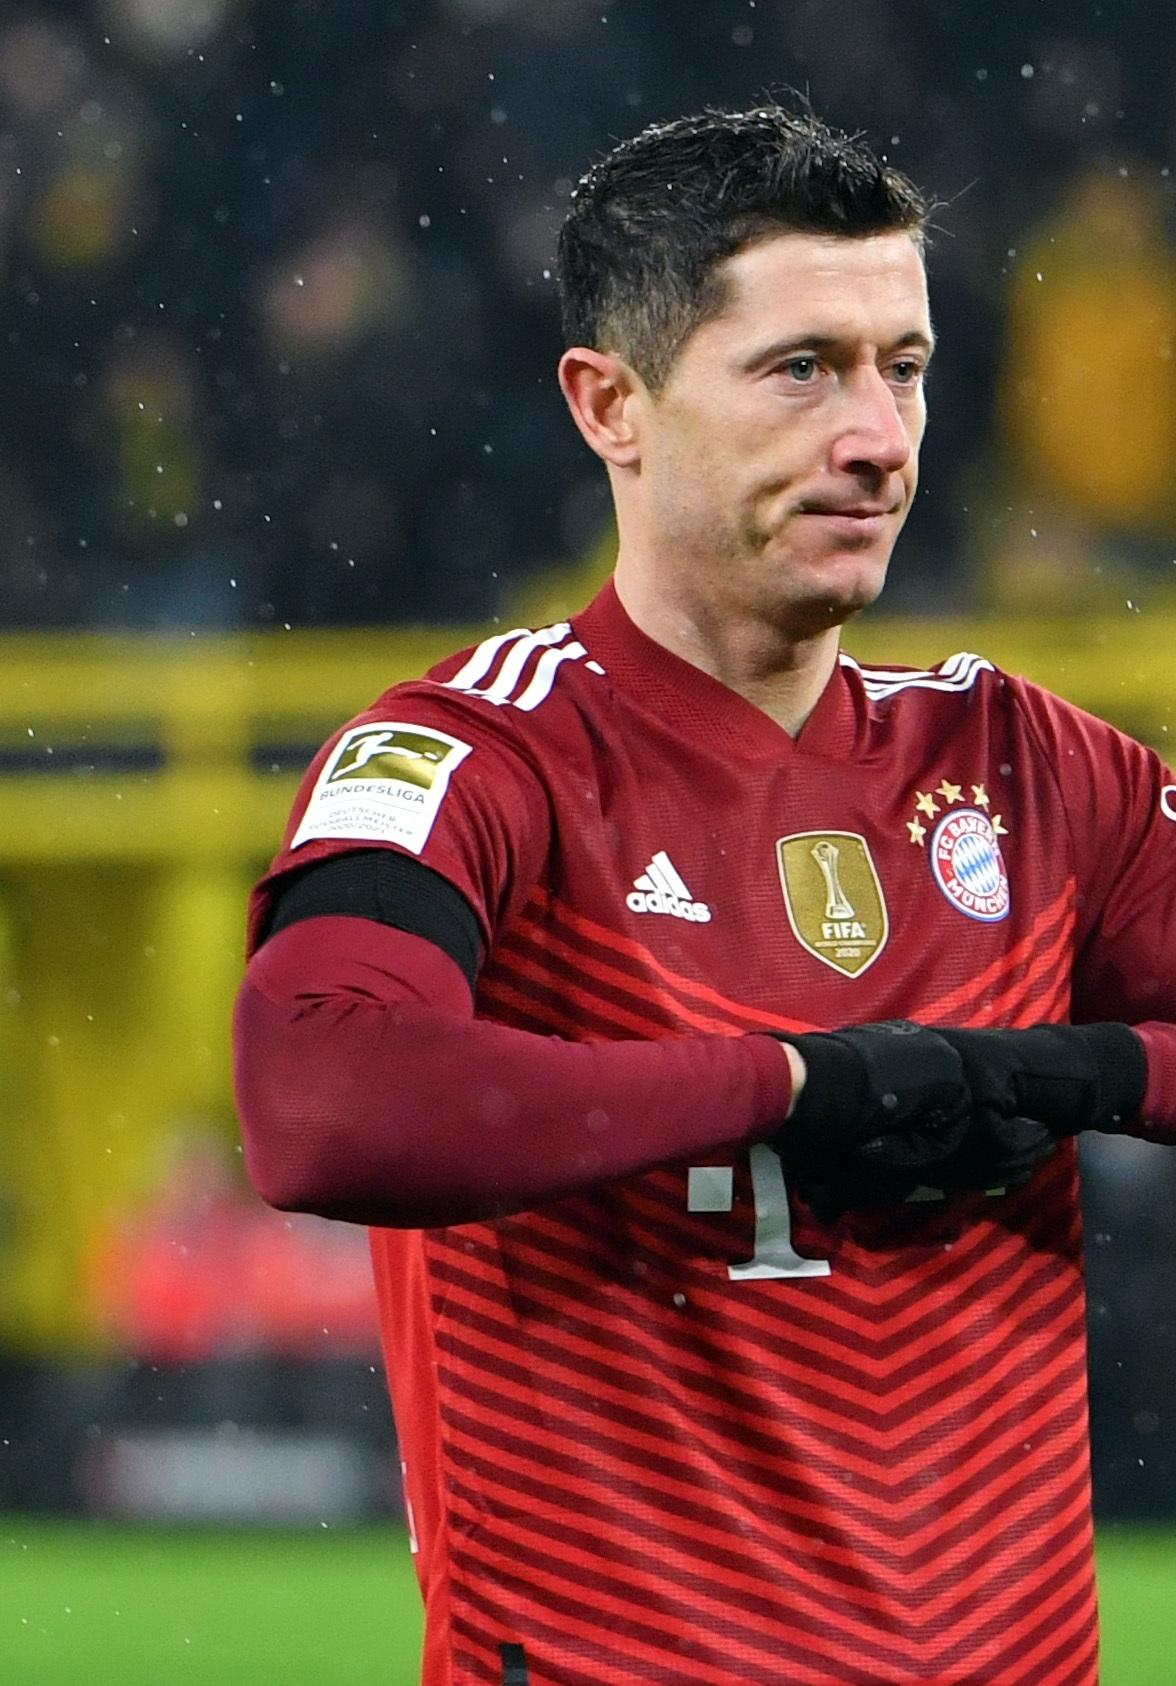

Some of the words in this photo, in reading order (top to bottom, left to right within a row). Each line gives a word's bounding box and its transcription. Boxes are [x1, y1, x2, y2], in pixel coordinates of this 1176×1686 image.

[320, 784, 425, 804] BUNDESLIGA
[938, 834, 954, 860] FC
[626, 890, 712, 923] adidas
[821, 921, 866, 939] FIFA
